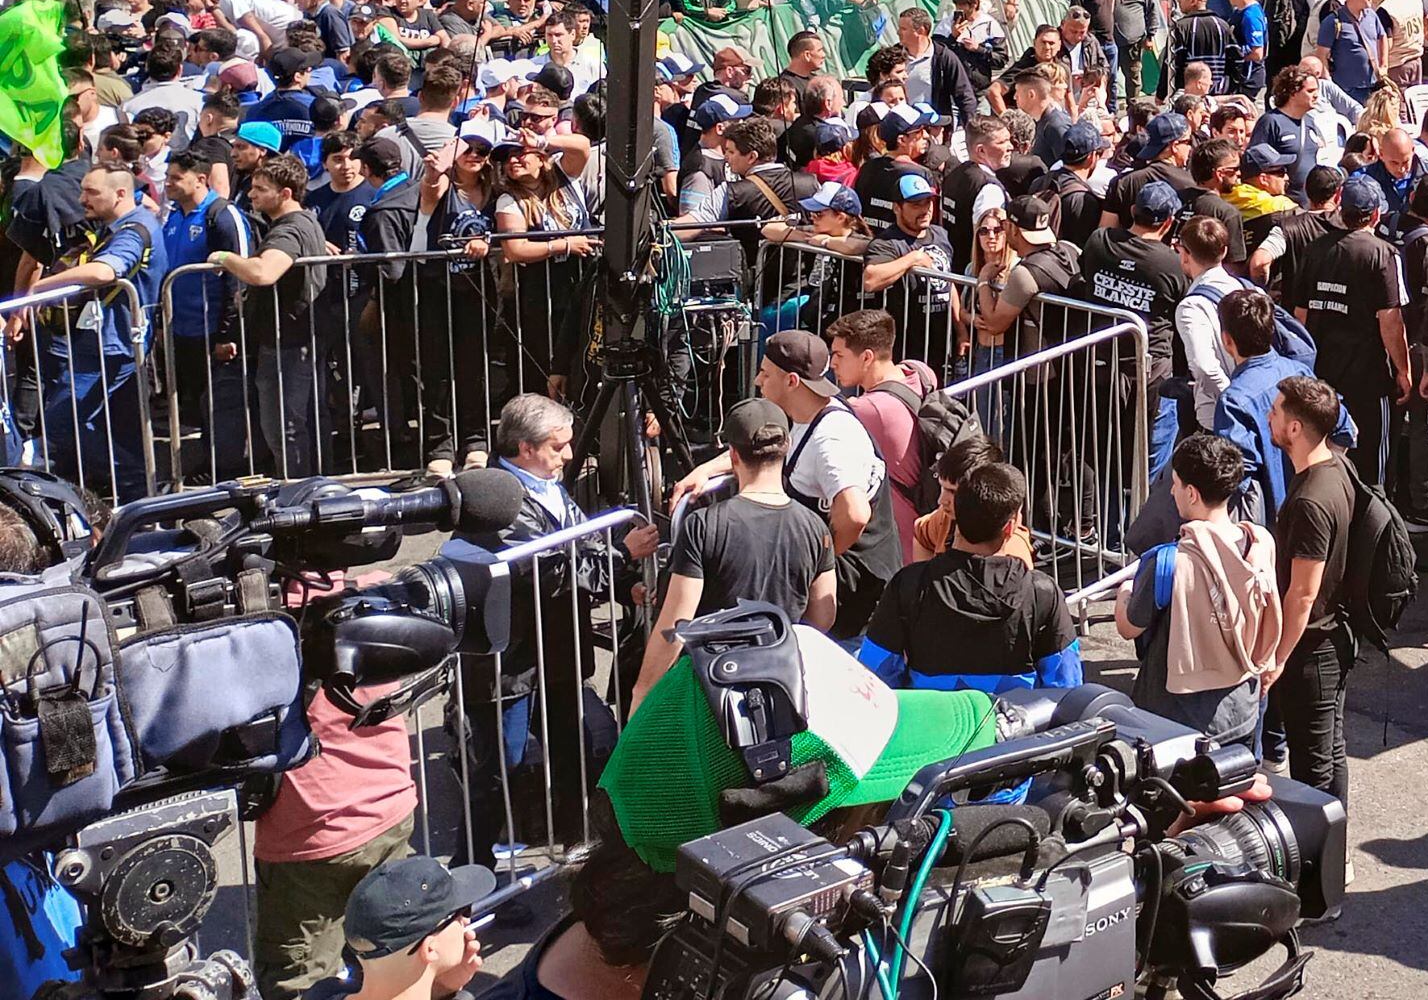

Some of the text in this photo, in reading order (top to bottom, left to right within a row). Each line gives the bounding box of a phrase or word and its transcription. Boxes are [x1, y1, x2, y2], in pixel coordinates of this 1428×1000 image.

[1093, 272, 1157, 301] CELESTE
[1093, 284, 1151, 312] BLANCA
[1085, 906, 1132, 937] SONY
